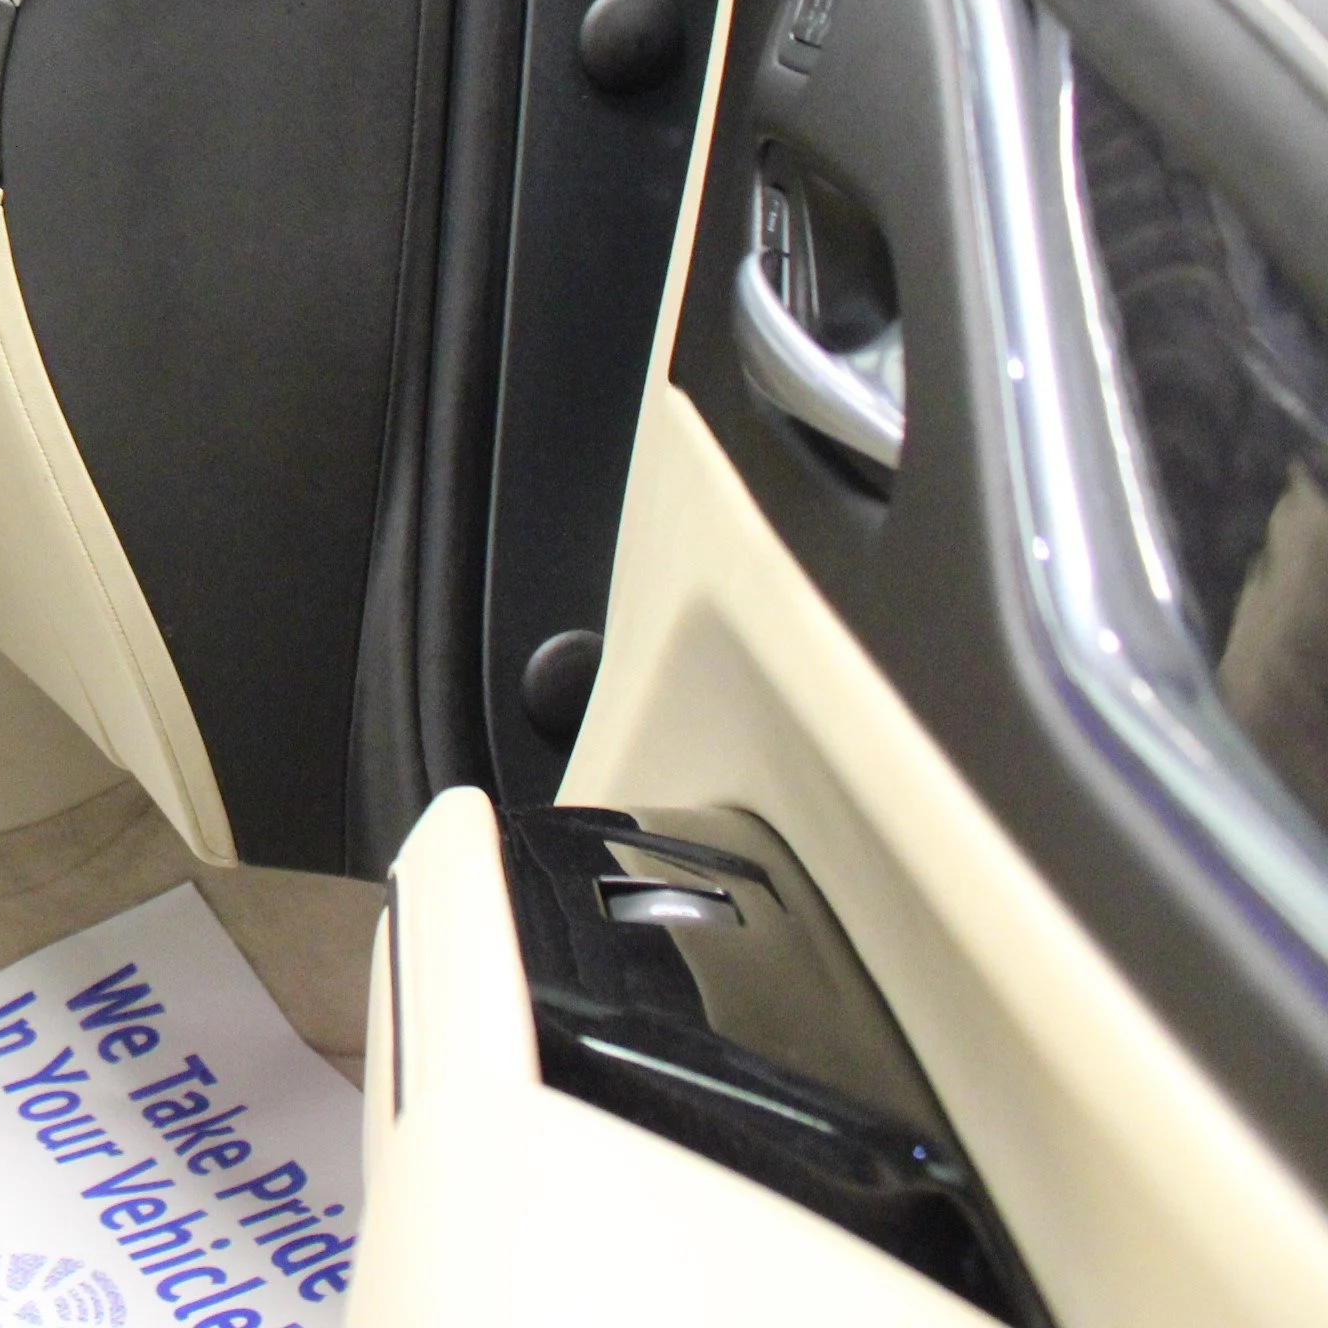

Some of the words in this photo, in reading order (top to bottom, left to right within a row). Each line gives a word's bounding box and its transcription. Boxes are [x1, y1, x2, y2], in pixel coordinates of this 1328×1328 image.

[2, 1046, 124, 1165] Your
[81, 1157, 301, 1328] Vehicle
[66, 963, 165, 1064] We
[129, 1054, 253, 1176] Take
[214, 1160, 358, 1303] Pride
